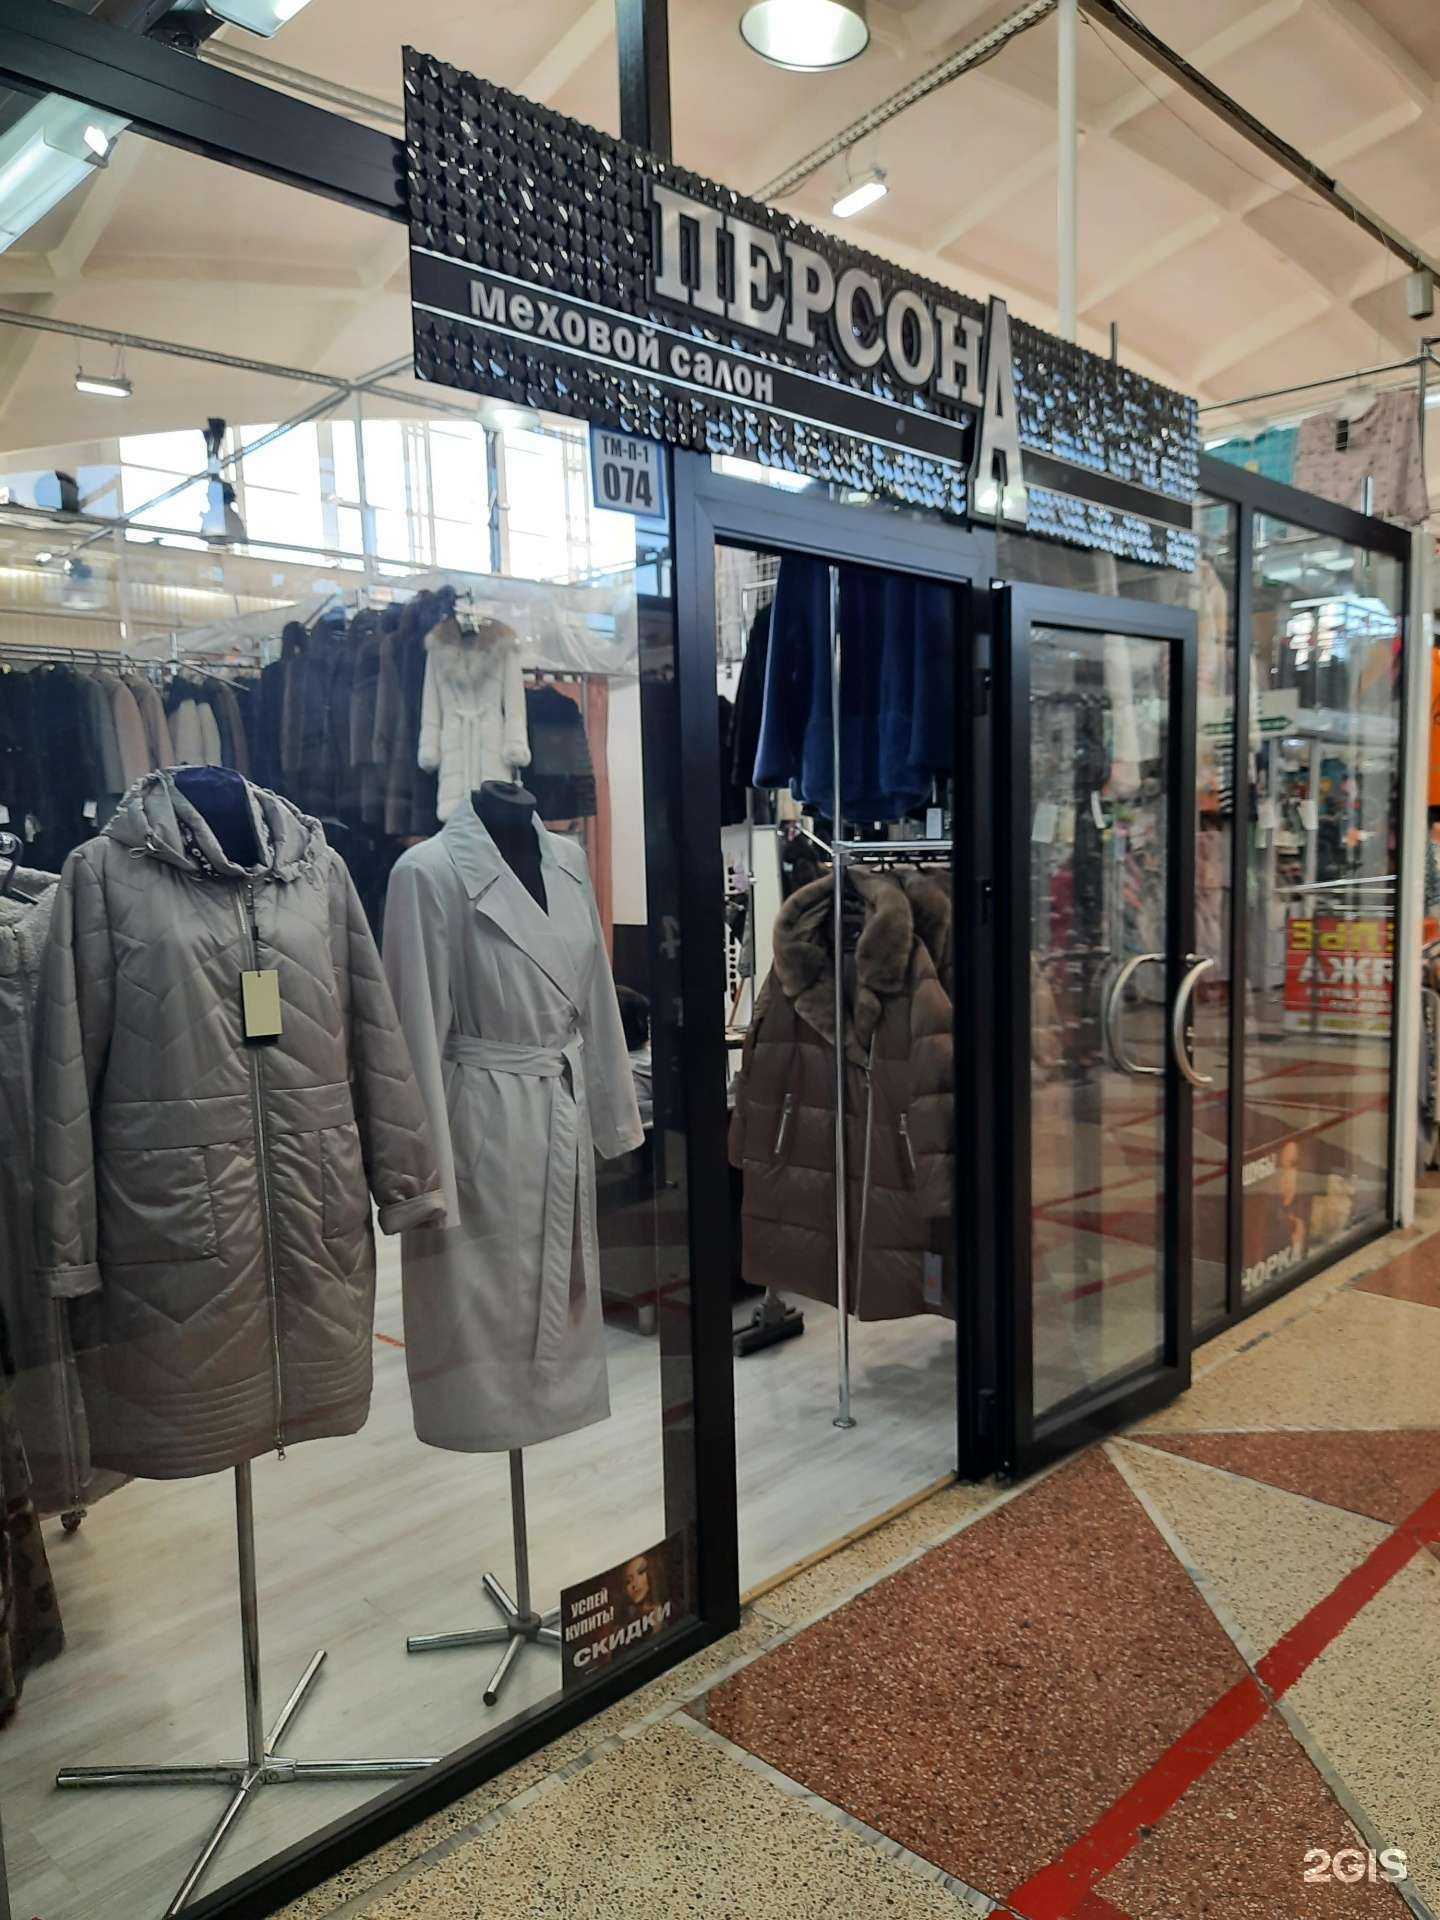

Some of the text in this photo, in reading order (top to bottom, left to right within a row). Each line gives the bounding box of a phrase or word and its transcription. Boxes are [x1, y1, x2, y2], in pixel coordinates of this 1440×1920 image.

[469, 279, 774, 404] Меховой салон
[652, 184, 1028, 524] ПЕРСОНА
[601, 434, 649, 465] ТМ-П-1
[603, 462, 653, 508] 074
[565, 1606, 614, 1642] КУПИТЬ!
[570, 1587, 609, 1618] УСПЕЙ
[572, 1600, 672, 1668] СКИДКИ
